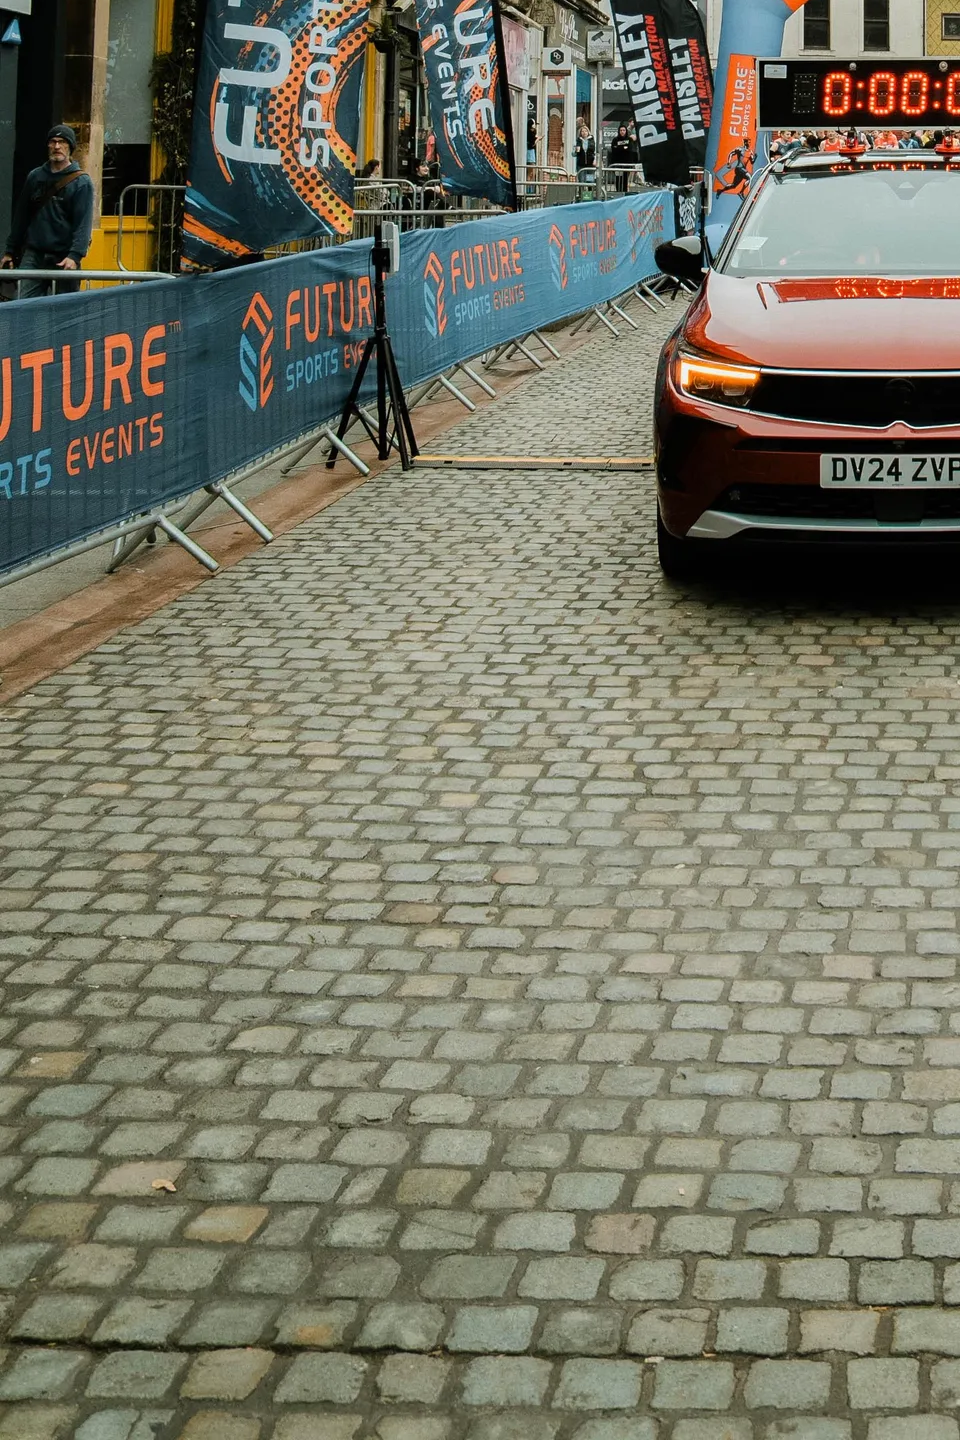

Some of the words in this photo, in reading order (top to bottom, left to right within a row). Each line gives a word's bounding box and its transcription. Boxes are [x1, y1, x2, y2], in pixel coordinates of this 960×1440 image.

[645, 14, 669, 93] MARATHON
[688, 38, 708, 99] MARATHON
[431, 23, 464, 138] EVENTS
[615, 13, 668, 147] PAISLEY
[668, 38, 705, 140] PAISLEY
[730, 67, 748, 137] FUTURE
[746, 69, 756, 101] EVENTS
[661, 97, 676, 130] HALF
[701, 102, 711, 128] HALF
[742, 104, 751, 137] SPORTS
[569, 217, 617, 259] FUTURE
[451, 236, 523, 295] FUTURE
[573, 262, 598, 283] SPORTS
[285, 272, 384, 350] FUTUR
[455, 294, 491, 325] SPORTS
[493, 284, 525, 310] EVENTS
[286, 348, 338, 392] SPORTS
[66, 412, 164, 476] EVENTS
[831, 457, 902, 482] DV24
